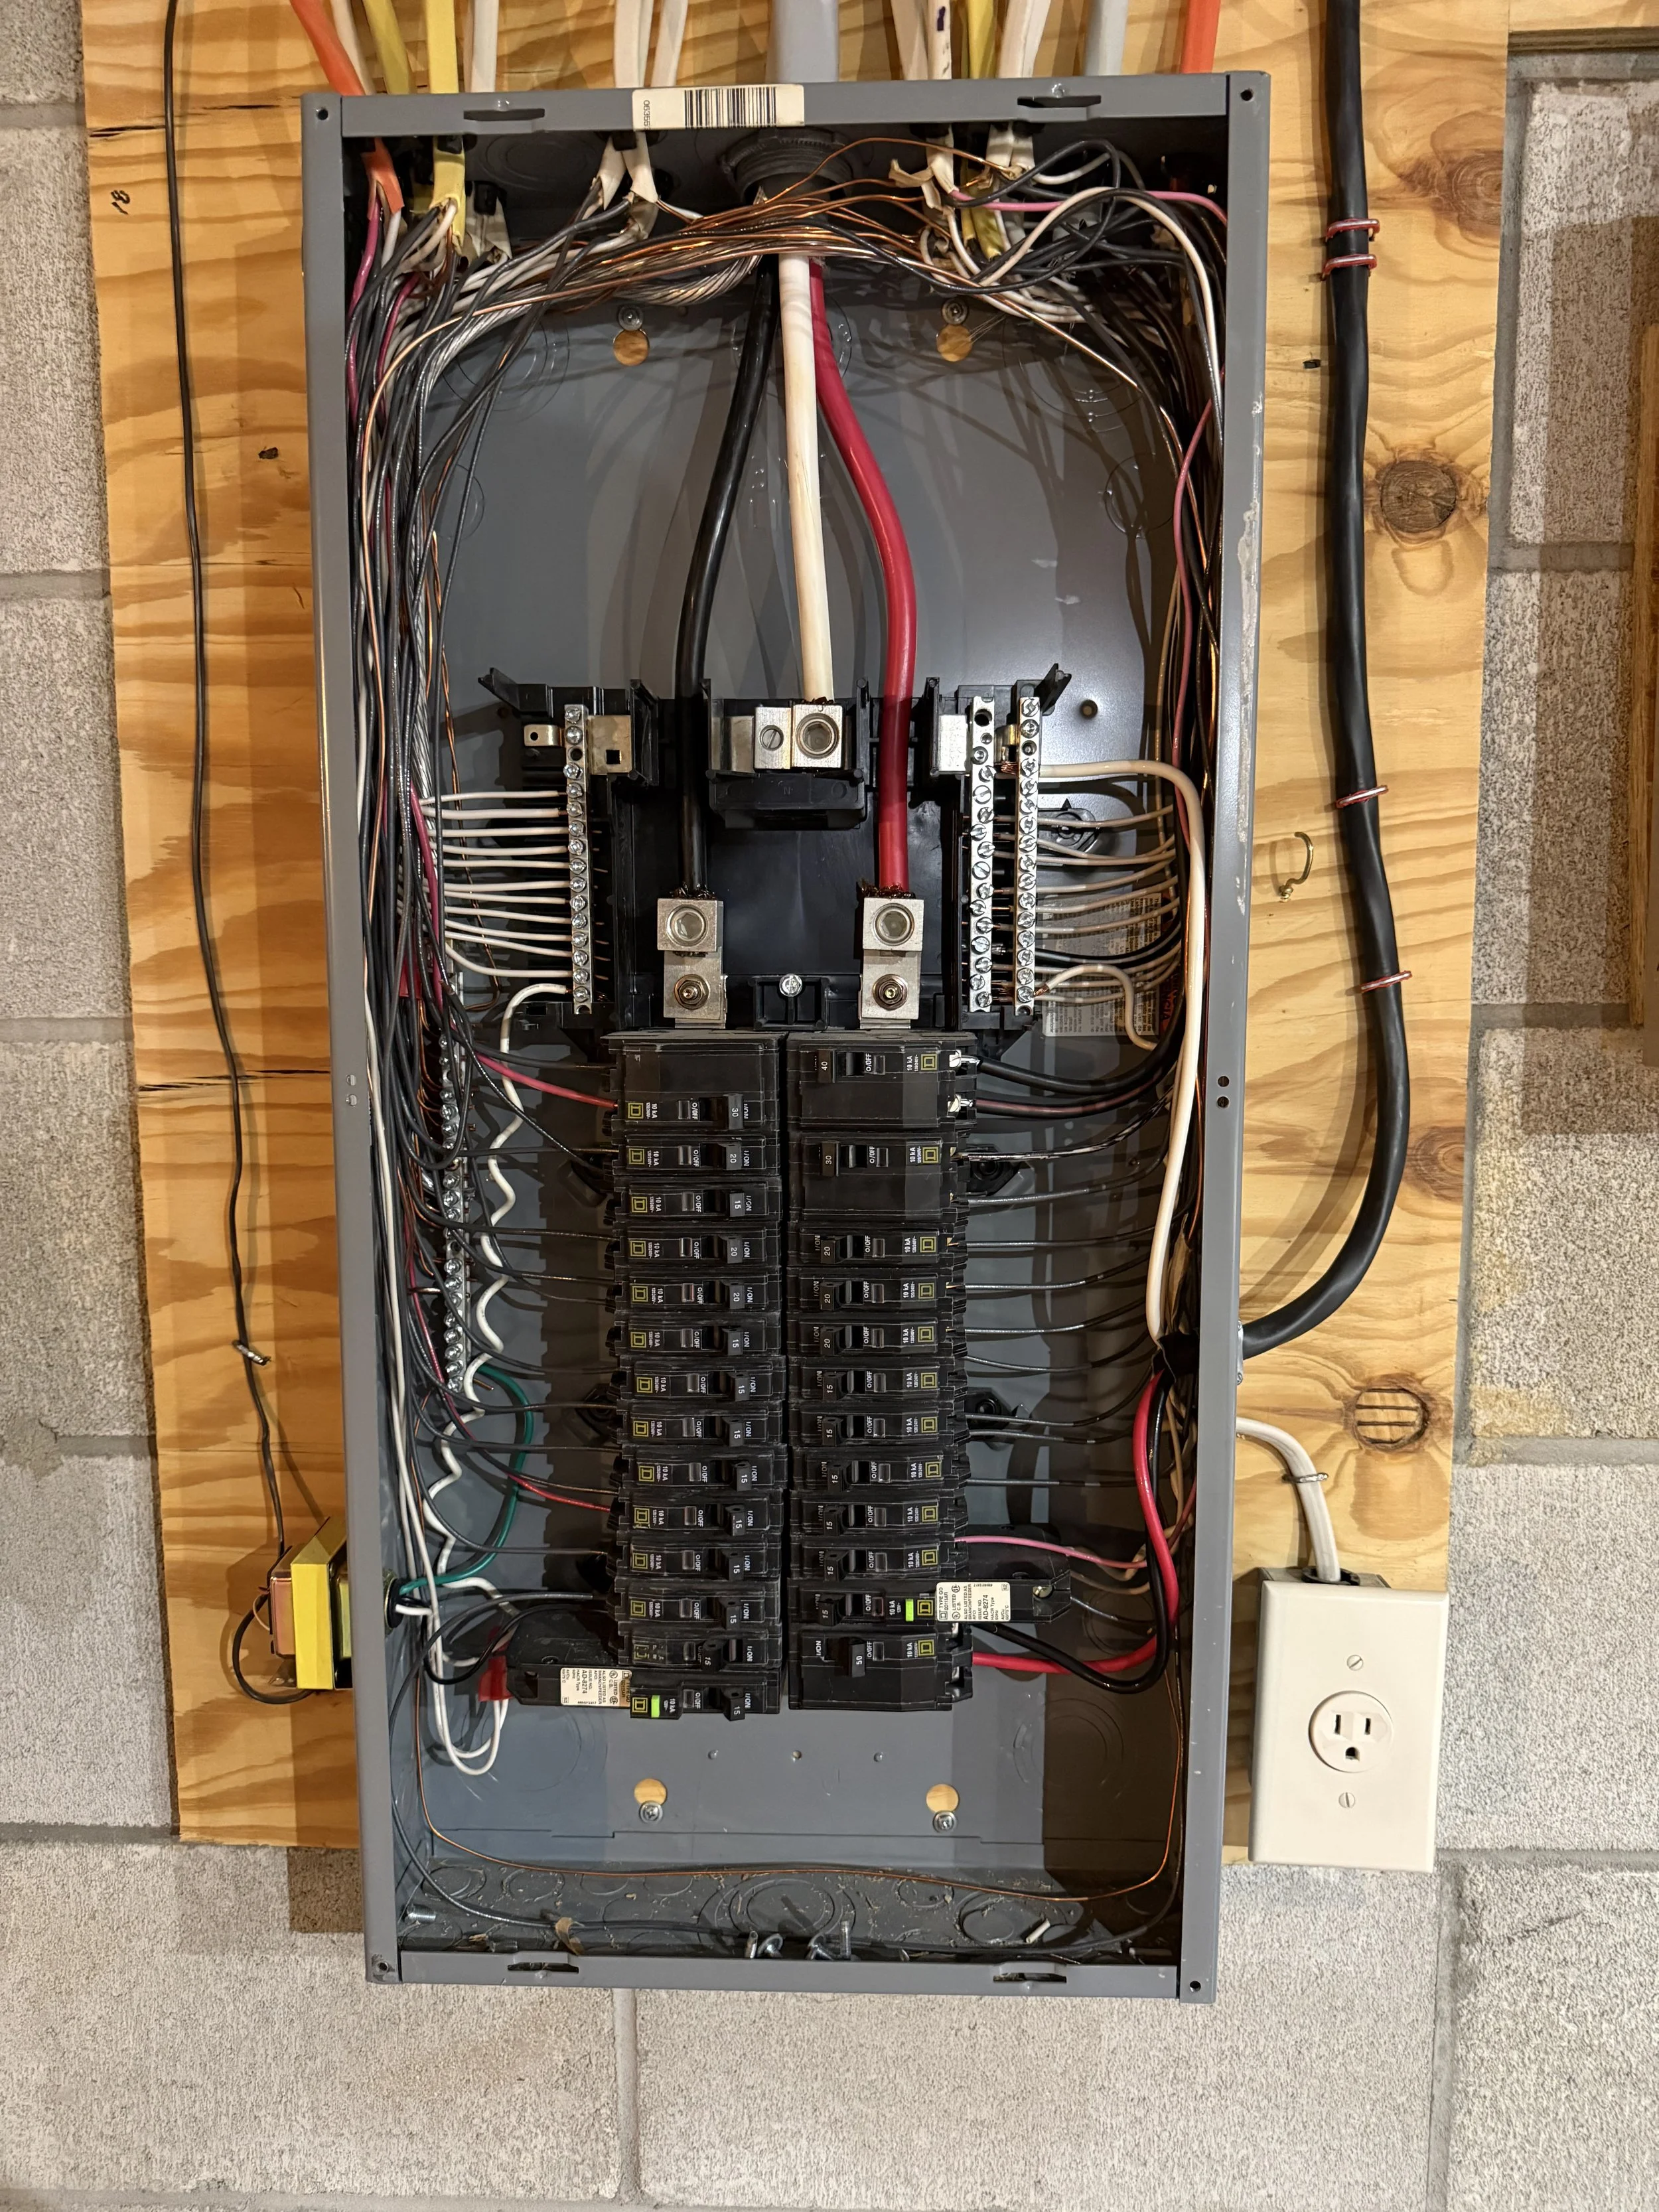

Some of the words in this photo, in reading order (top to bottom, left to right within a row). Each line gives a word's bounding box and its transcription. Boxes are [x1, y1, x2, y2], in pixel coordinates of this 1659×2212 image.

[822, 1062, 828, 1070] 40
[732, 1108, 739, 1117] 30
[730, 1154, 737, 1163] 20
[826, 1155, 831, 1164] 30
[735, 1201, 741, 1209] 15
[731, 1247, 737, 1256] 20
[824, 1246, 830, 1256] 20
[733, 1293, 740, 1301] 20
[824, 1294, 830, 1303] 20
[733, 1339, 739, 1348] 15
[824, 1339, 830, 1348] 20
[739, 1385, 745, 1394] 15
[734, 1430, 741, 1439] 15
[741, 1475, 747, 1483] 15
[735, 1520, 742, 1528] 15
[734, 1565, 740, 1574] 15
[828, 1566, 833, 1575] 15
[730, 1615, 737, 1623] 15
[856, 1656, 862, 1665] 50
[734, 1706, 741, 1715] 15
